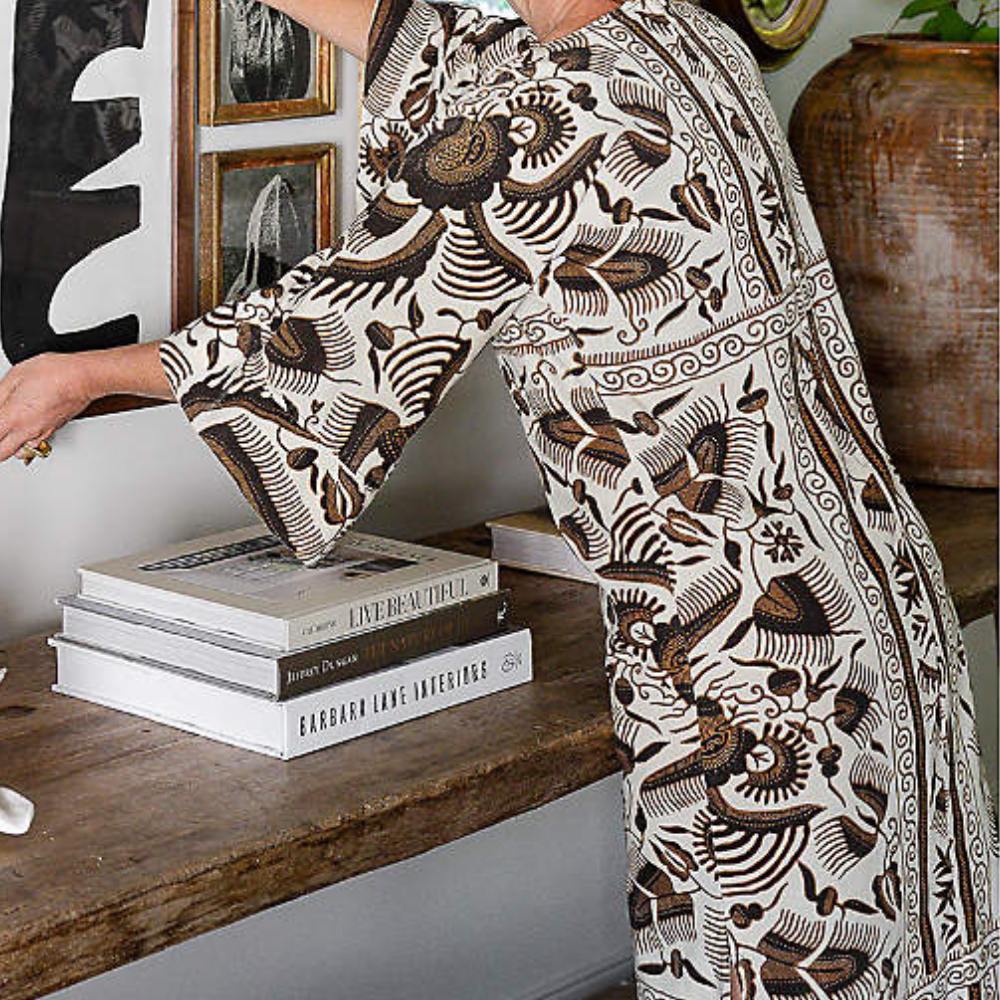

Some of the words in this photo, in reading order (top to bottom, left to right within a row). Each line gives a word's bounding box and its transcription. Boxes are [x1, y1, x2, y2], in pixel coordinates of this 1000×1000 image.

[350, 602, 385, 628] LIVE
[387, 578, 469, 617] BEAUTIFUL
[299, 698, 365, 737] BARBARA
[373, 686, 407, 714] LANE
[413, 659, 488, 702] INTERIORS
